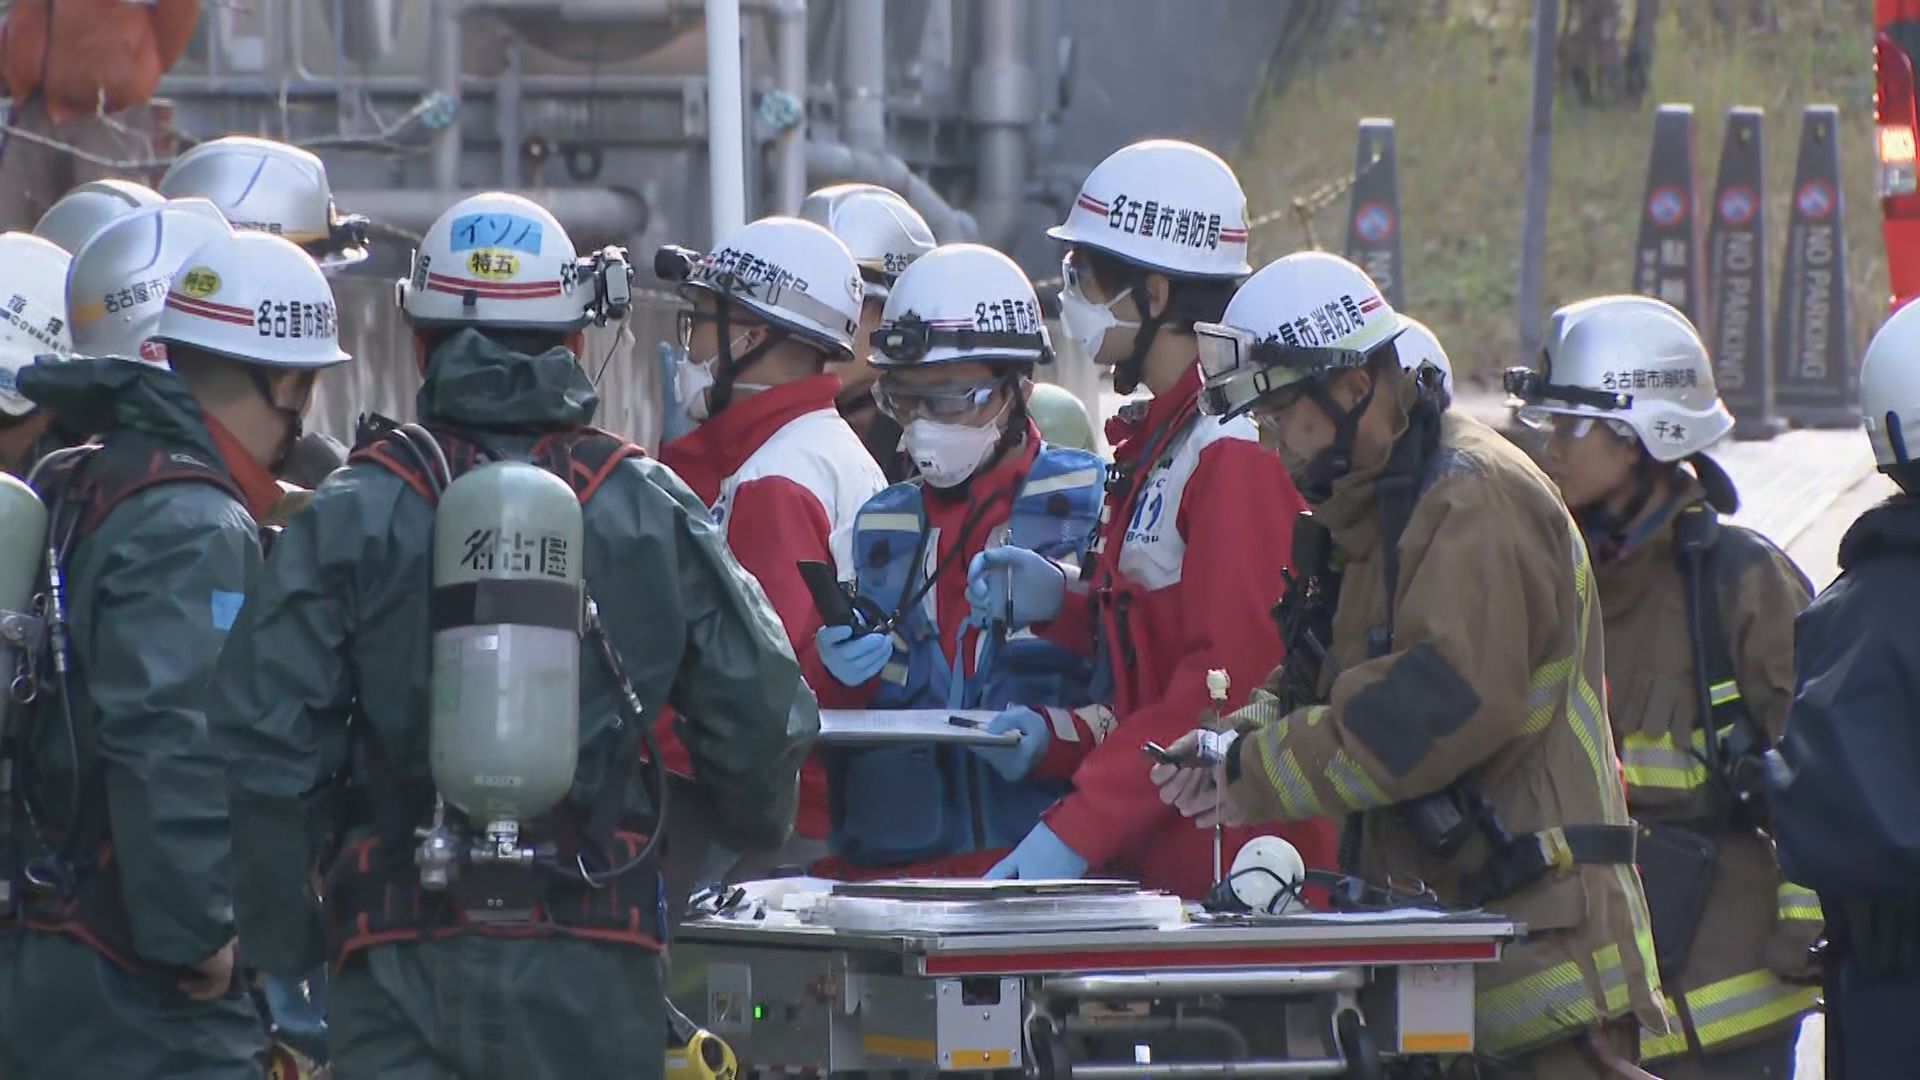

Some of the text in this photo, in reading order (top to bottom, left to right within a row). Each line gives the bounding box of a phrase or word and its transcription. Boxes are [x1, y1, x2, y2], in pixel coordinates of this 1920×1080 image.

[460, 215, 531, 246] イソノ
[1109, 193, 1221, 250] 名古屋市消防局
[472, 252, 513, 274] 特五
[1602, 368, 1697, 390] 名古屋市消防局
[460, 528, 567, 577] 名古屋
